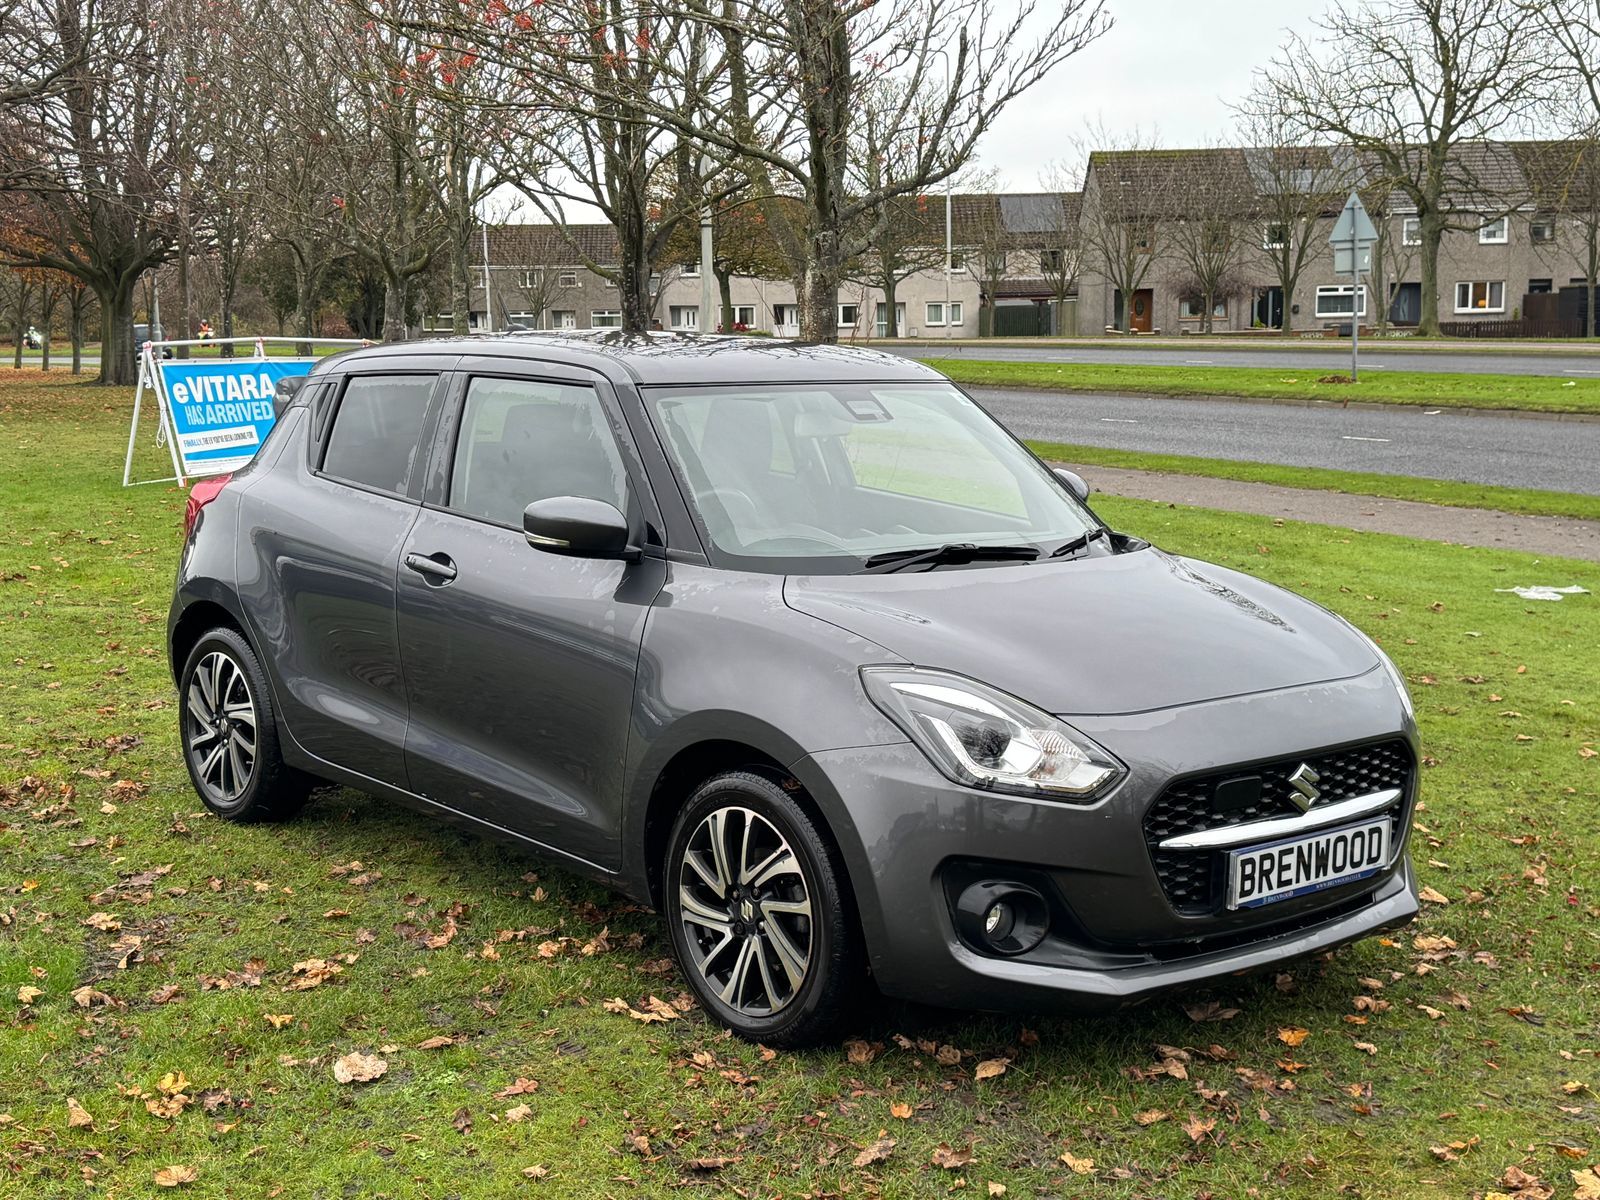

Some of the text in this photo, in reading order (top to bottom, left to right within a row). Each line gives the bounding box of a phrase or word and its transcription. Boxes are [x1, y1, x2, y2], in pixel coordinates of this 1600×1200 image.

[172, 373, 276, 404] eVITARA
[184, 401, 273, 426] HAS ARRIVED
[1239, 826, 1383, 899] BRENWOOD
